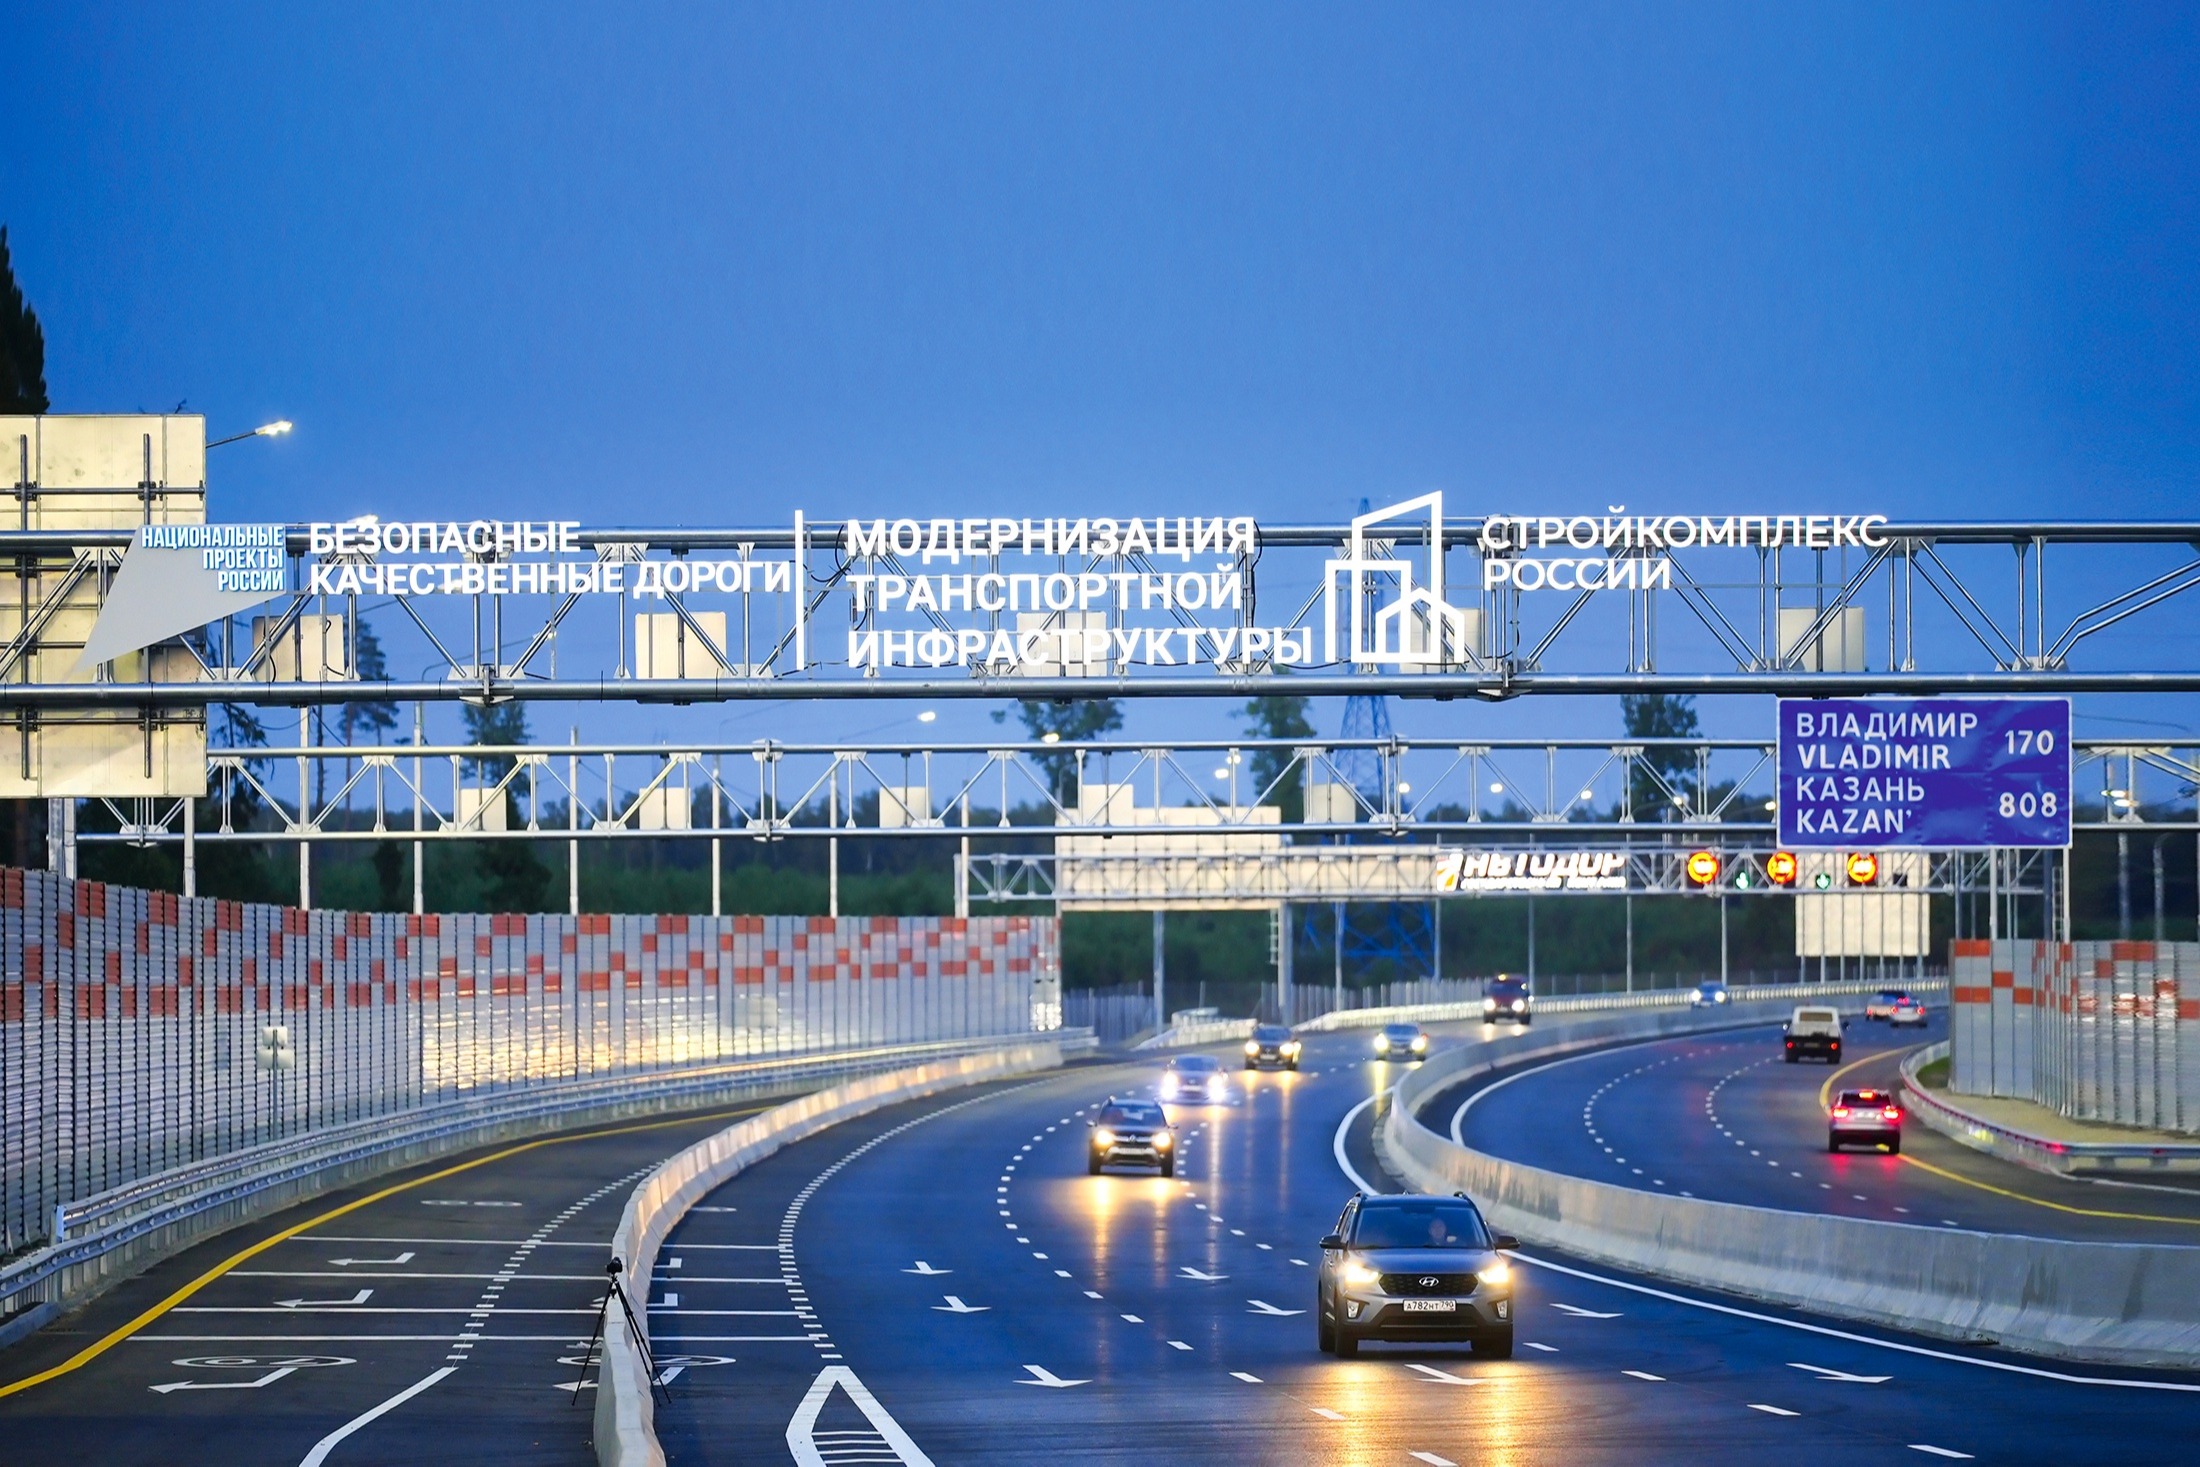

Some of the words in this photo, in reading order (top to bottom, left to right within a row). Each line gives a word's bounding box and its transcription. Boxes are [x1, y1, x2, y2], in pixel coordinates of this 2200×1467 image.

[142, 526, 284, 549] НАЦИОНАЛЬНЫЕ
[310, 520, 581, 554] БЕЗОПАСНЫЕ
[846, 516, 1256, 565] МОДЕРНИЗАЦИЯ
[1482, 505, 1888, 549] СТРОЙКОМПЛЕКС
[203, 549, 283, 569] ПРОЕКТЫ
[218, 570, 284, 591] РОССИИ
[310, 561, 624, 595] КАЧЕСТВЕННЫЕ
[632, 560, 791, 599] ДОРОГИ
[846, 563, 1242, 612] ТРАНСПОРТНОЙ
[1484, 558, 1670, 591] РОССИИ
[847, 626, 1312, 668] ИНФРАСТРУКТУРЫ
[1796, 712, 1978, 741] ВЛАДИМИР
[1797, 744, 1951, 769] VLADIMIR
[2004, 730, 2054, 755] 170
[1796, 776, 1925, 802] КАЗАНЬ
[1999, 792, 2057, 818] 808
